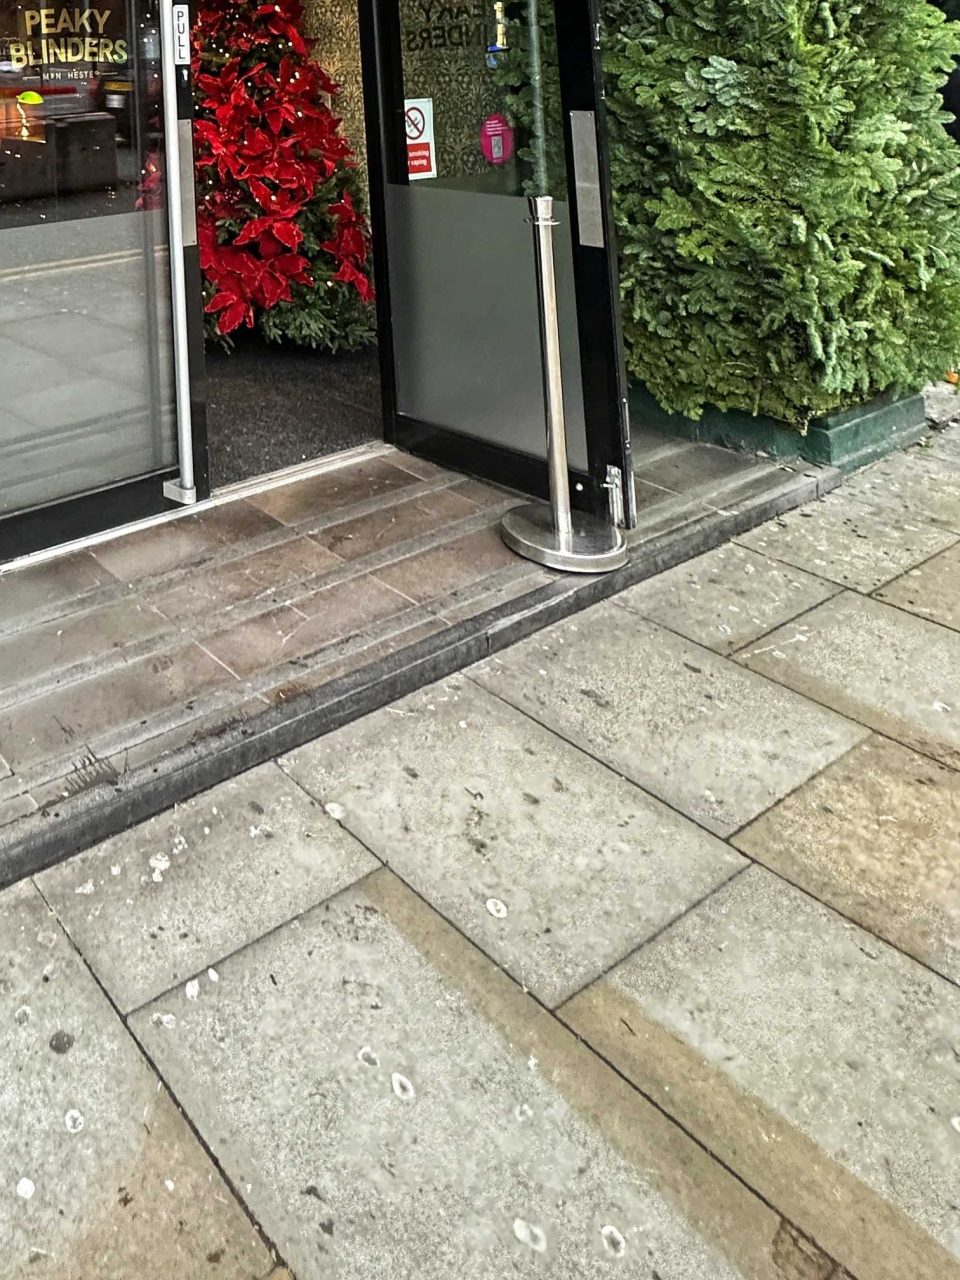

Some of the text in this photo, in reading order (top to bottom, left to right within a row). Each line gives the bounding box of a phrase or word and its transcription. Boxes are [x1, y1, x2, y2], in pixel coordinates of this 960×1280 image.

[25, 8, 111, 35] PEAKY
[177, 10, 186, 60] PULL
[9, 37, 128, 69] BLINDERS
